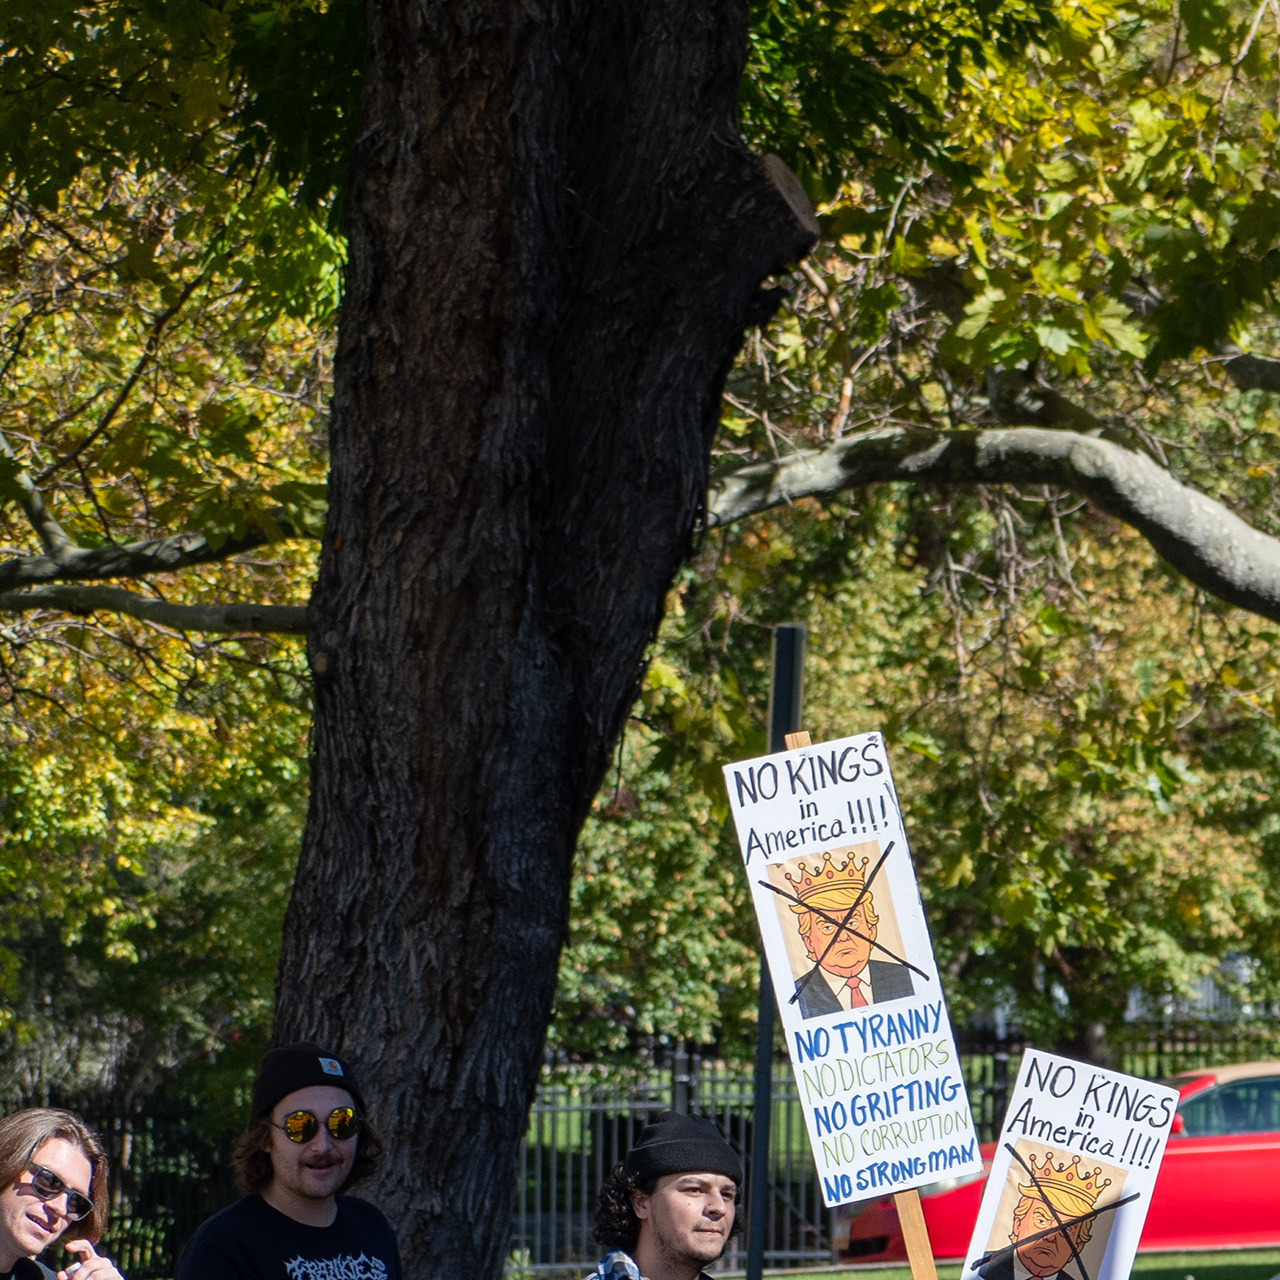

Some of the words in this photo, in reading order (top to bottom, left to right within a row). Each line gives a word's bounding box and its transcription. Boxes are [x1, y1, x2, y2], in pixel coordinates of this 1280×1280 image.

[734, 762, 779, 807] NO
[786, 743, 883, 795] KINGS
[800, 798, 818, 819] in
[795, 1027, 830, 1063] NO
[832, 1000, 942, 1053] TYRANNY
[803, 1063, 836, 1105] NO
[836, 1039, 950, 1091] DICTATORS
[1024, 1058, 1076, 1100] NO
[1085, 1073, 1172, 1129] KINGS
[813, 1101, 848, 1137] NO
[851, 1075, 962, 1127] GRIFTING
[822, 1132, 855, 1168] NO
[860, 1105, 969, 1156] CORRUPTION
[1075, 1107, 1095, 1131] in
[823, 1173, 853, 1203] NO
